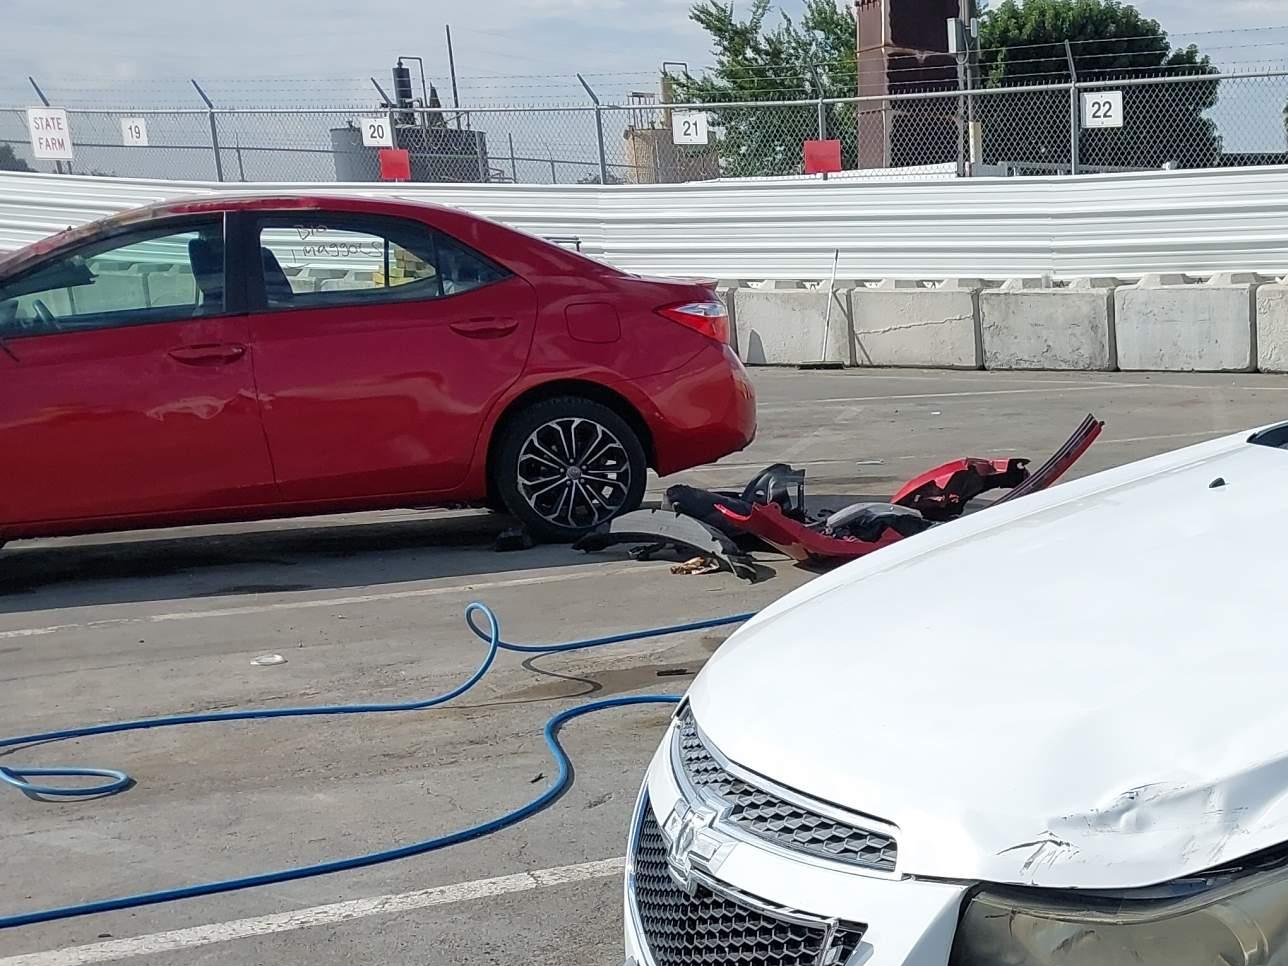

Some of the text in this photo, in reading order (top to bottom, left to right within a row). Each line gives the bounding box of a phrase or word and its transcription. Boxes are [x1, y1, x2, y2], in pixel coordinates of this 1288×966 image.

[1091, 101, 1112, 118] 22
[33, 116, 64, 131] STATE
[683, 120, 698, 136] 21
[128, 125, 141, 140] 19
[369, 124, 385, 139] 20
[37, 137, 66, 151] FARM
